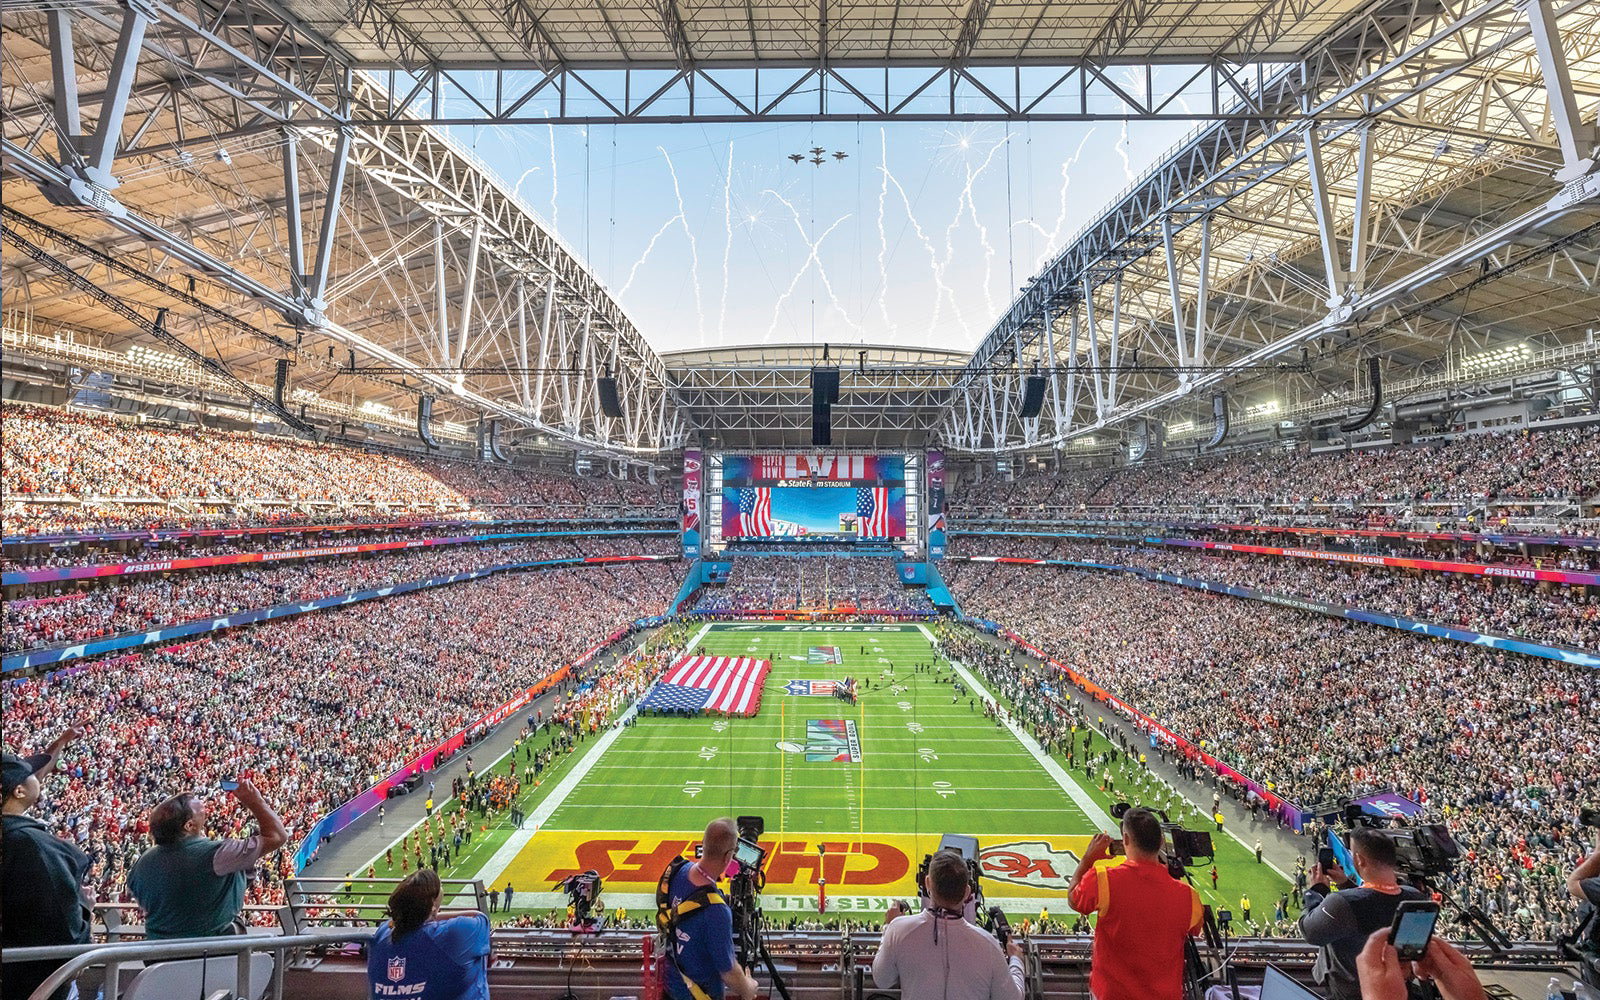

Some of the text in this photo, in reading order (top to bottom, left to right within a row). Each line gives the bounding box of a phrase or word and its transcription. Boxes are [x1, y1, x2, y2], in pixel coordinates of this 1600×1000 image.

[762, 456, 782, 466] SUPER
[784, 455, 864, 478] LVII
[762, 466, 782, 478] BOWL
[262, 546, 359, 560] NATIONAL FOOTBALL LEAGUE
[1282, 550, 1385, 564] NATIONAL FOOTBALL LEAGUE
[124, 562, 172, 573] #SBLVII
[1484, 567, 1536, 579] #SBLVII
[782, 624, 901, 632] EAGLES
[850, 739, 860, 759] SUPER
[682, 780, 705, 793] 10
[932, 781, 956, 794] 10
[544, 839, 909, 885] CHFS
[837, 898, 921, 910] TKES
[375, 981, 427, 995] FILMS
